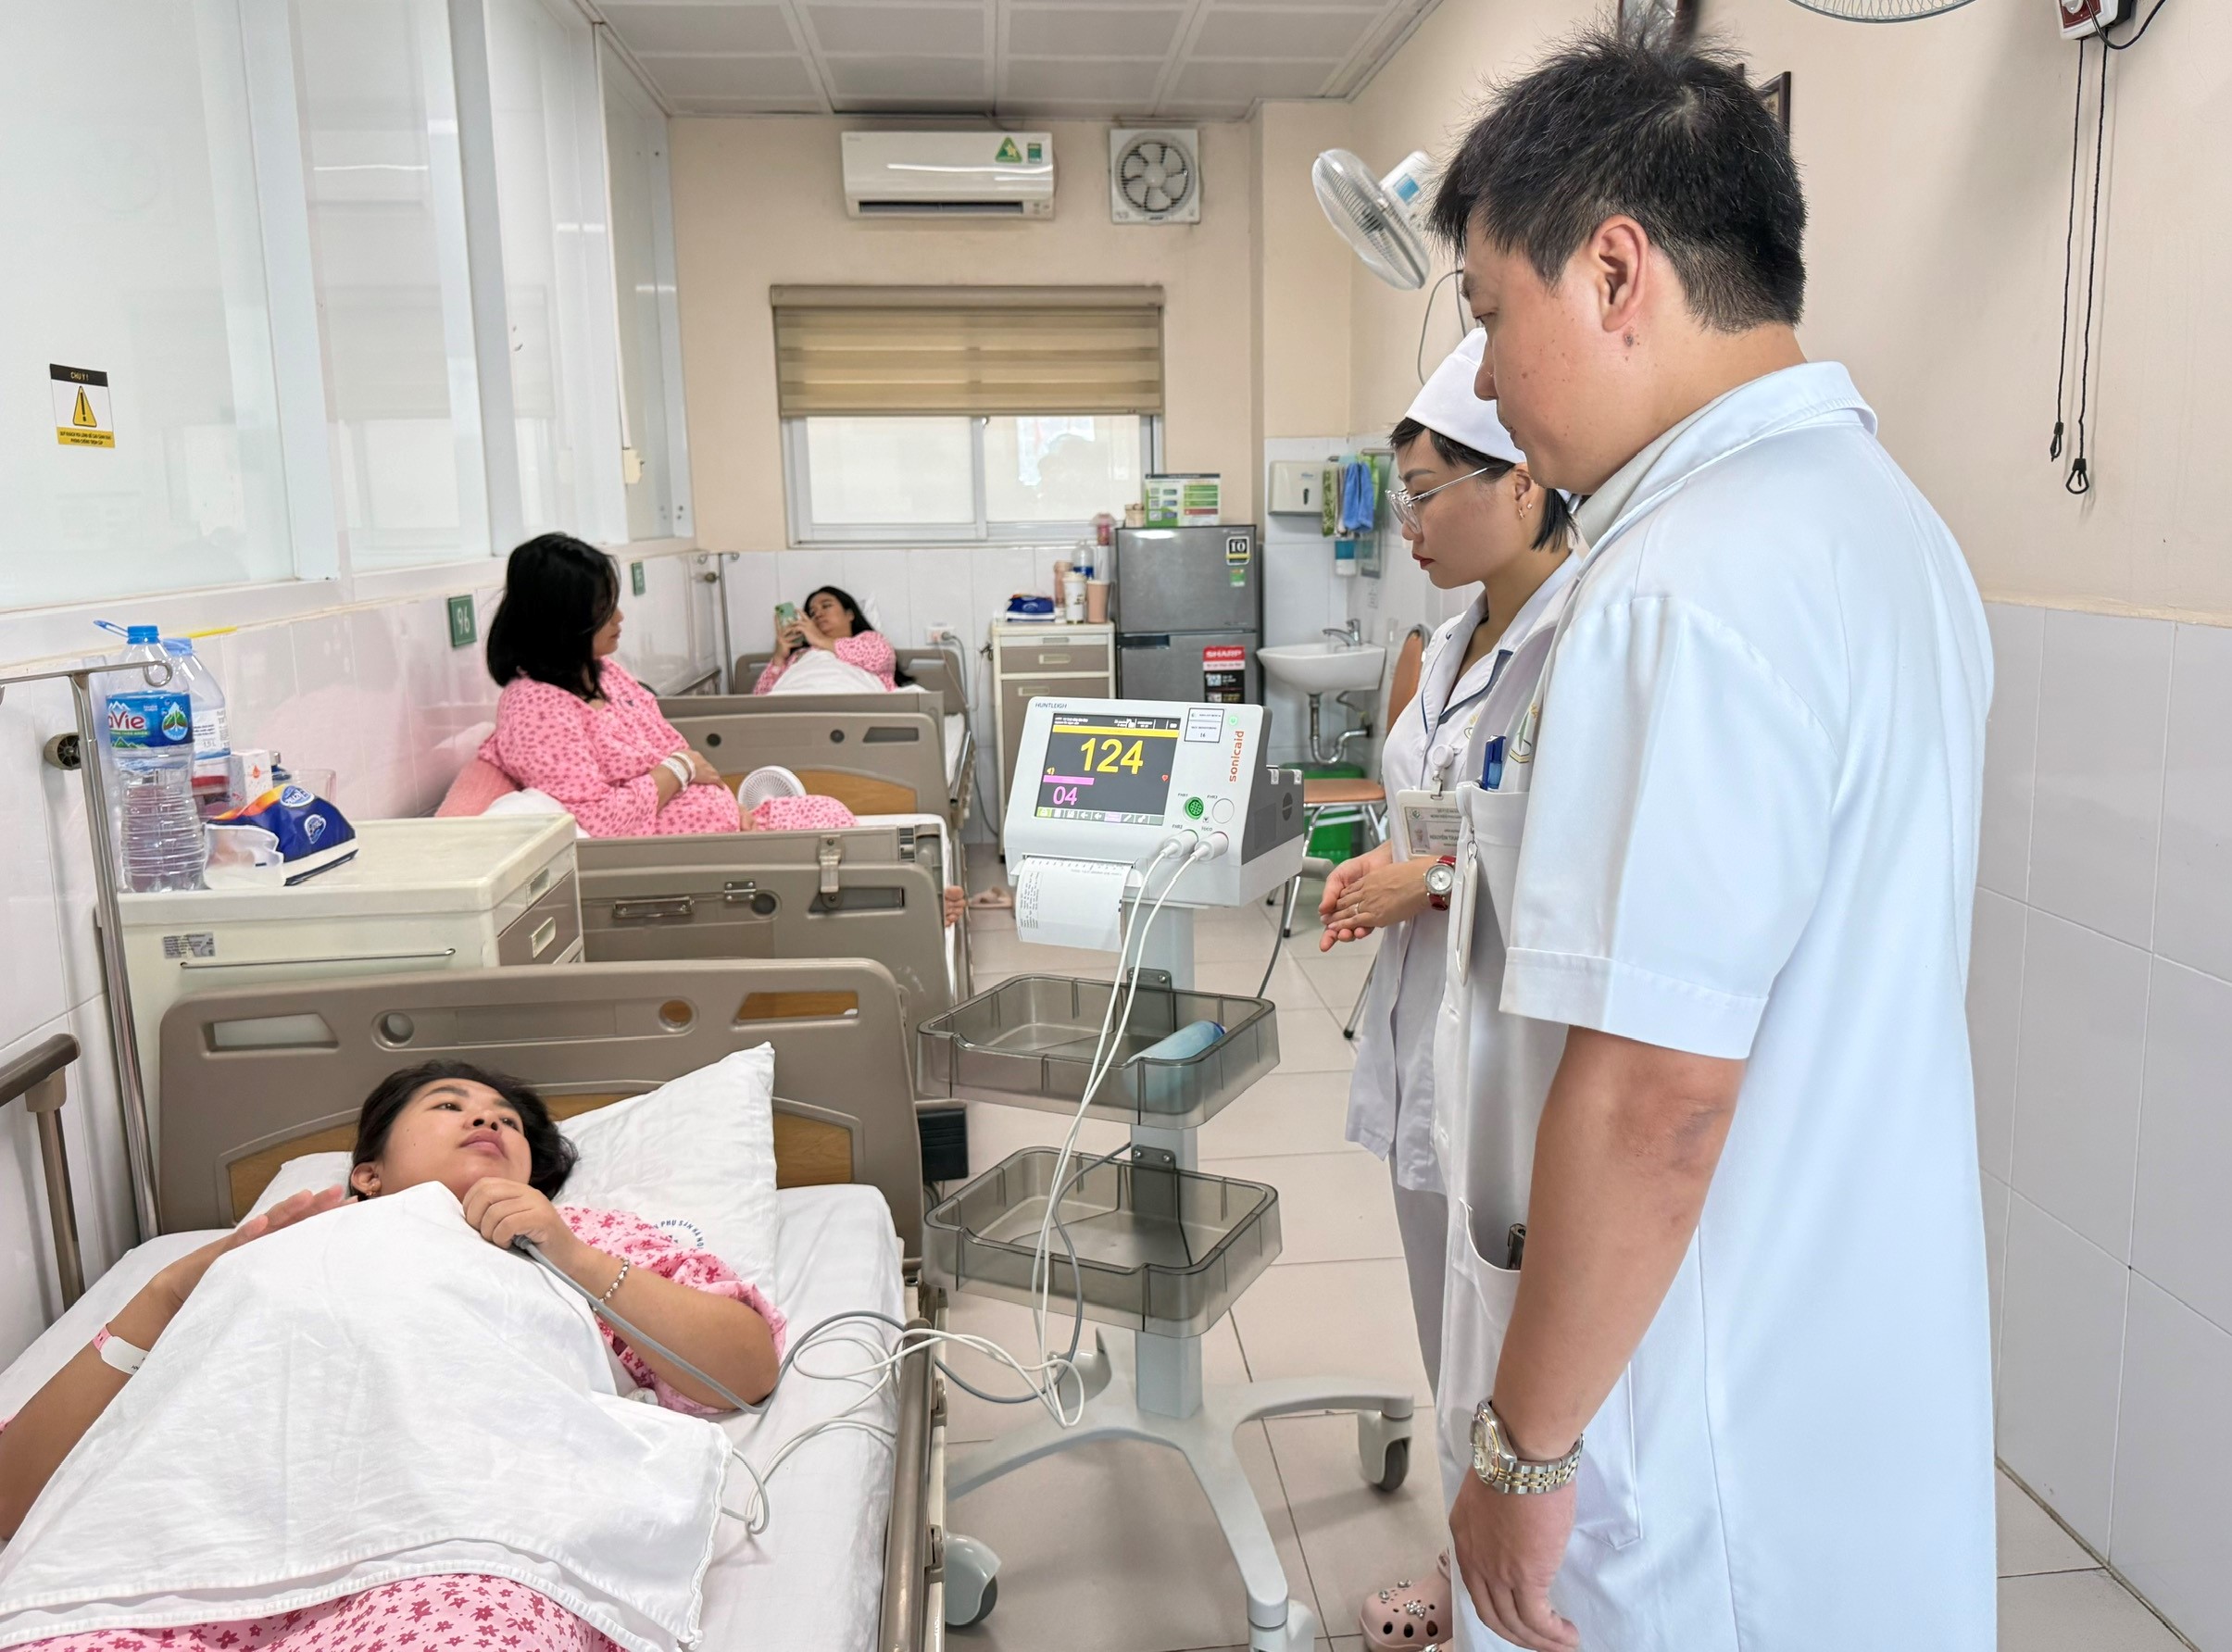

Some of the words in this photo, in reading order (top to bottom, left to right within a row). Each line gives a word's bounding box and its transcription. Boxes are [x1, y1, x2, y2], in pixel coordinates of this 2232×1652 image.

[1231, 542, 1246, 552] 10
[458, 606, 470, 635] 96
[1206, 650, 1242, 658] SHARP
[107, 710, 144, 729] aVie
[1081, 737, 1144, 775] 124
[1229, 731, 1244, 782] sonicaid
[1053, 785, 1078, 806] 04
